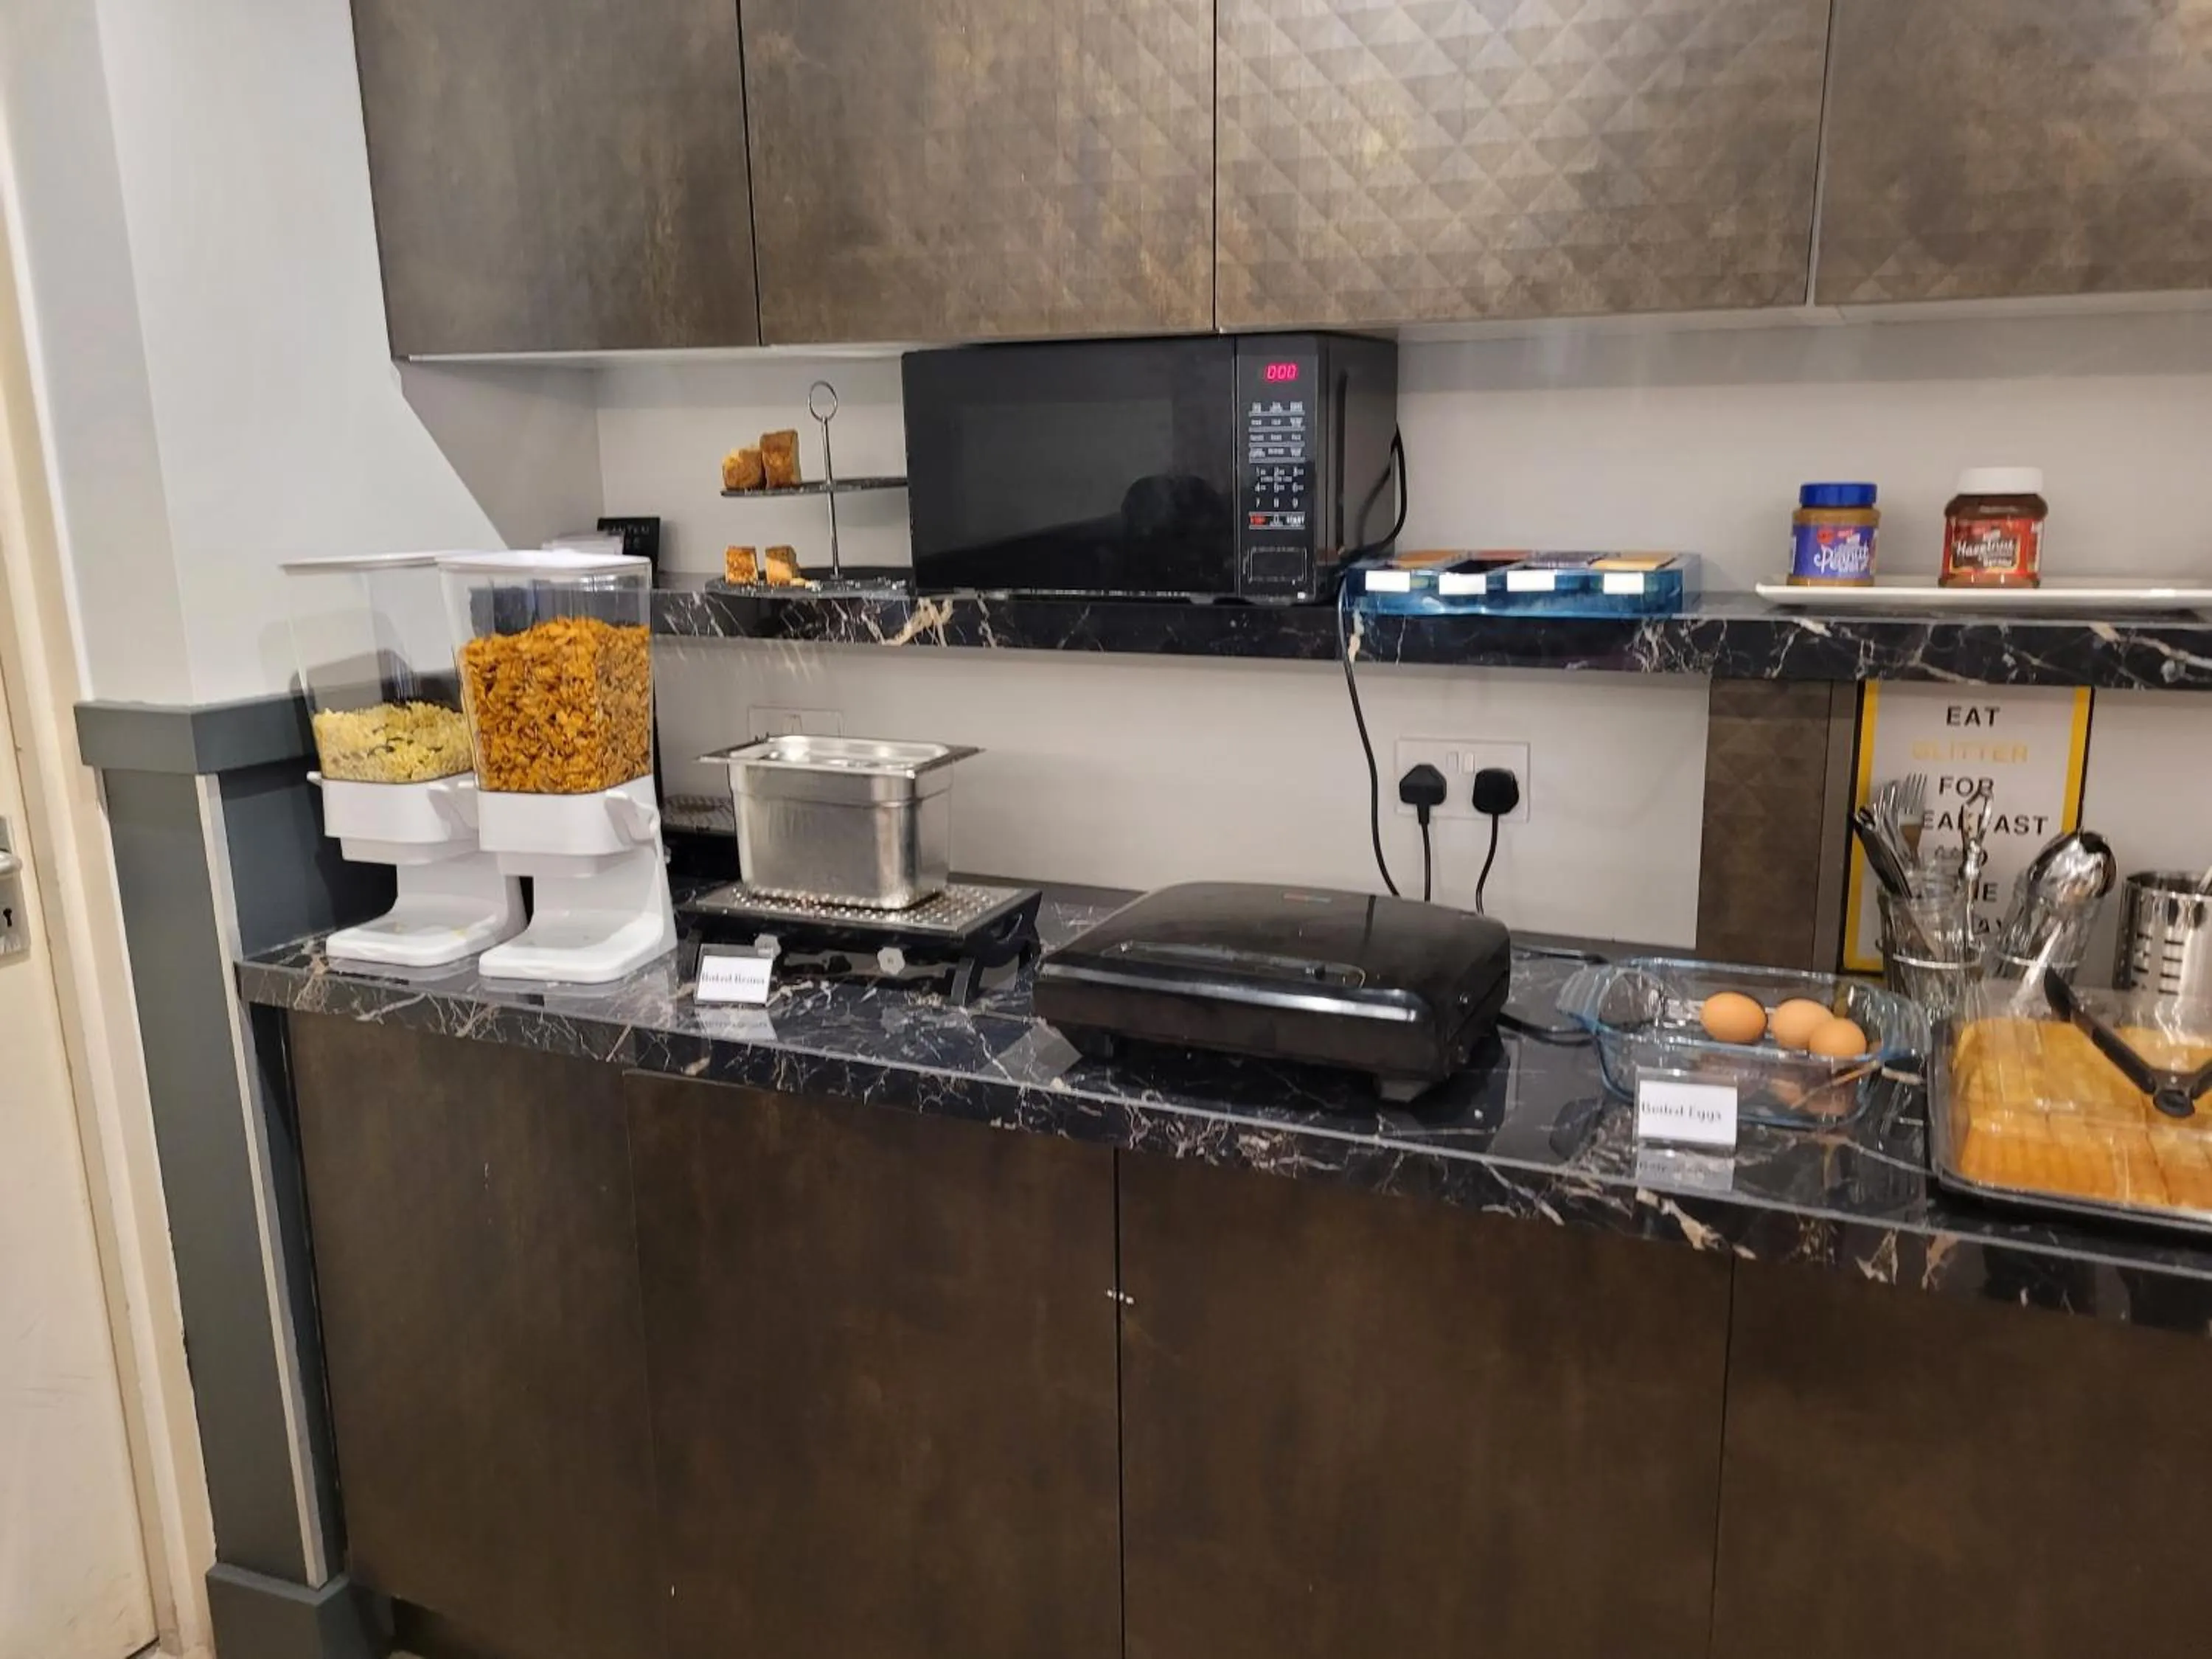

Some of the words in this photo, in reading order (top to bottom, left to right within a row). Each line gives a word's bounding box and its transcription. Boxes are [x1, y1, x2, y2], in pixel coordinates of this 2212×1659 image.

[1946, 706, 2000, 727] EAT
[1911, 740, 2028, 764] GLITTER
[1938, 776, 1994, 799] FOR
